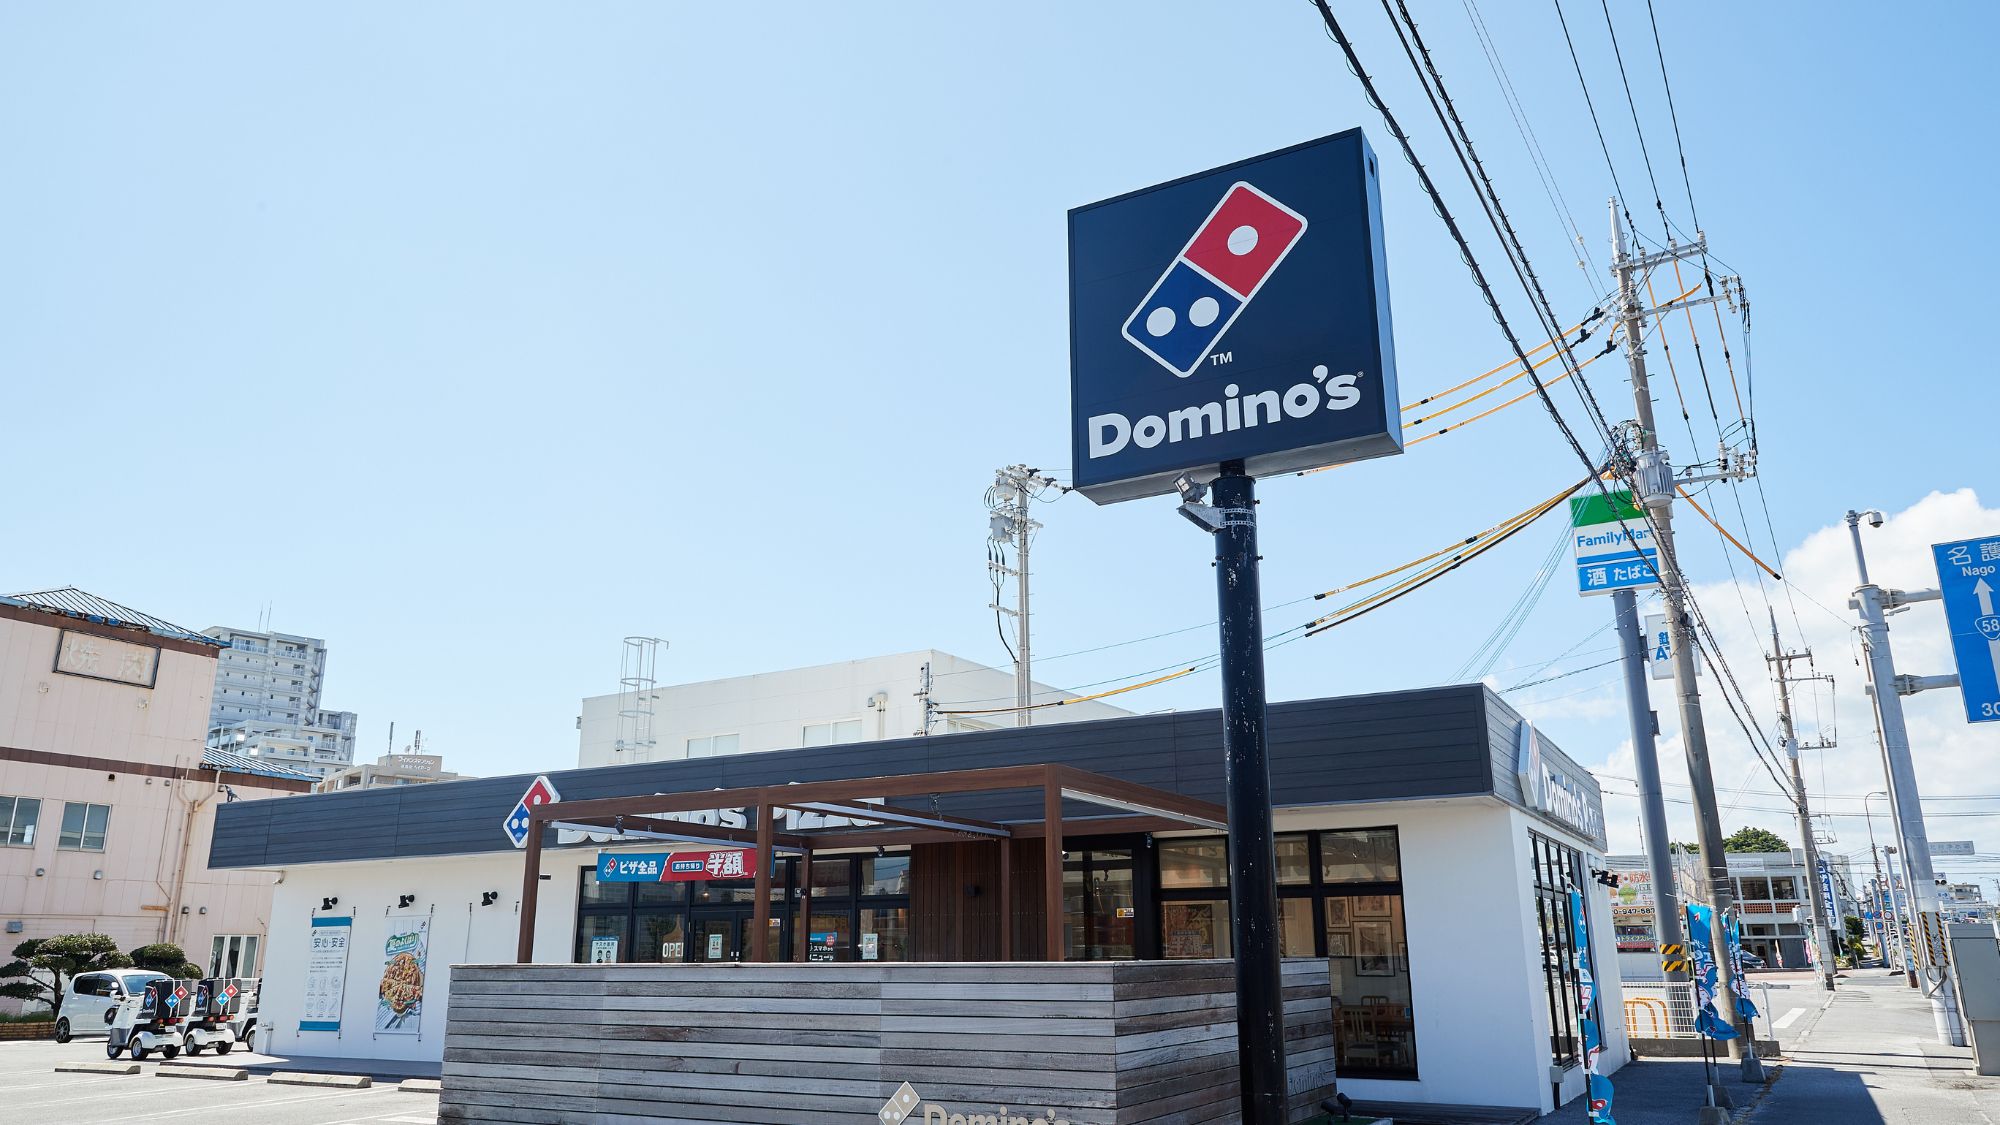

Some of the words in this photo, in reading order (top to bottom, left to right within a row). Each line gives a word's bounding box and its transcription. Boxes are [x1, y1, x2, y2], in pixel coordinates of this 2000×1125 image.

[1211, 352, 1232, 366] TM
[1088, 364, 1361, 459] Domino's
[1587, 567, 1607, 586] 酒
[1962, 566, 1996, 577] Nago
[619, 860, 658, 875] ピザ全品
[706, 851, 744, 877] 半額
[313, 937, 346, 949] 安心・安全
